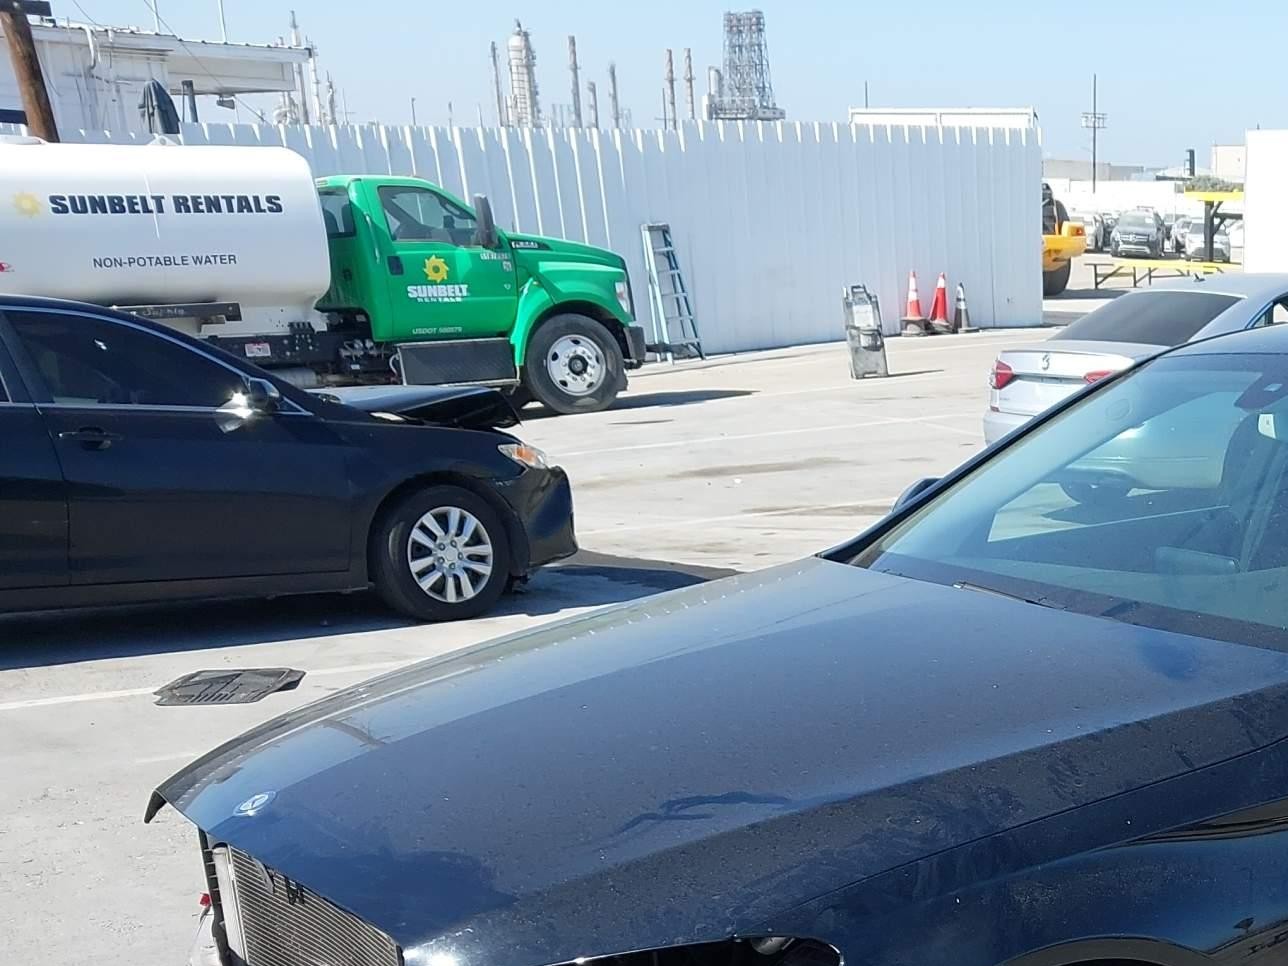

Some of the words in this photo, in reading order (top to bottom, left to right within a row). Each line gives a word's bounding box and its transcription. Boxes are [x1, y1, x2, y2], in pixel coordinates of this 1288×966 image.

[49, 194, 166, 215] SUNBELT
[172, 194, 284, 214] RENTALS
[93, 256, 189, 269] NON-POTABLE
[191, 254, 237, 266] WATER
[407, 284, 469, 298] SUNBELT
